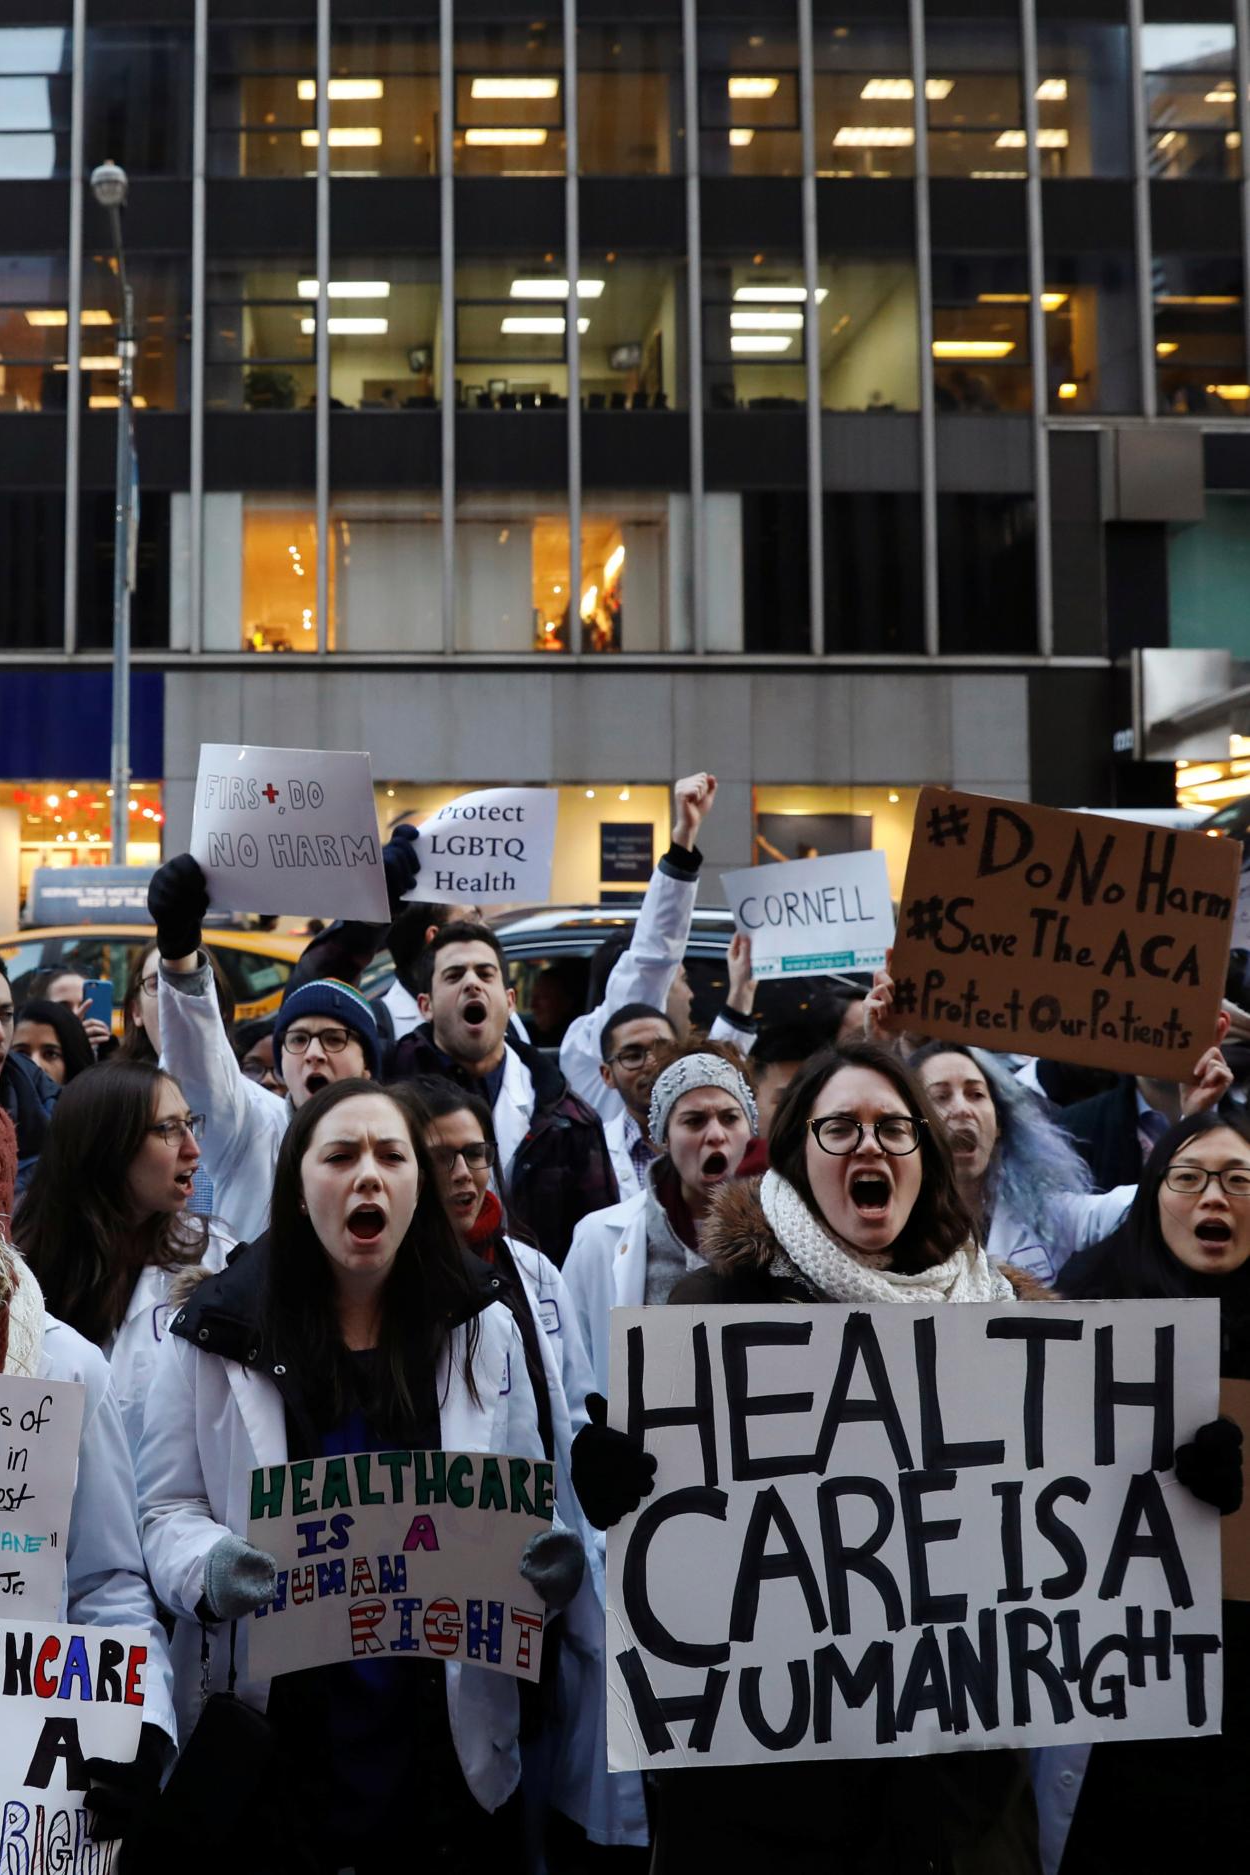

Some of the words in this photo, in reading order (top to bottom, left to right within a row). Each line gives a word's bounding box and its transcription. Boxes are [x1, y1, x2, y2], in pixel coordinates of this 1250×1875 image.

[288, 780, 324, 810] DO
[438, 804, 525, 822] Protect
[208, 832, 259, 868] NO
[268, 834, 377, 868] HARM
[430, 834, 527, 862] LGBTQ
[434, 871, 516, 892] Health
[739, 886, 875, 929] CORNELL
[19, 1396, 53, 1434] of
[627, 1311, 1175, 1486] HEALTH
[7, 1444, 27, 1472] in
[250, 1451, 555, 1521] HEALTHCARE
[296, 1513, 355, 1558] IS
[402, 1514, 440, 1551] A
[0, 1571, 25, 1596] Jr.
[254, 1554, 407, 1620] HUMAN
[623, 1469, 968, 1668] CARE
[991, 1476, 1092, 1602] IS
[1098, 1470, 1194, 1608] A
[348, 1597, 544, 1669] RIGHT
[23, 1717, 92, 1791] A
